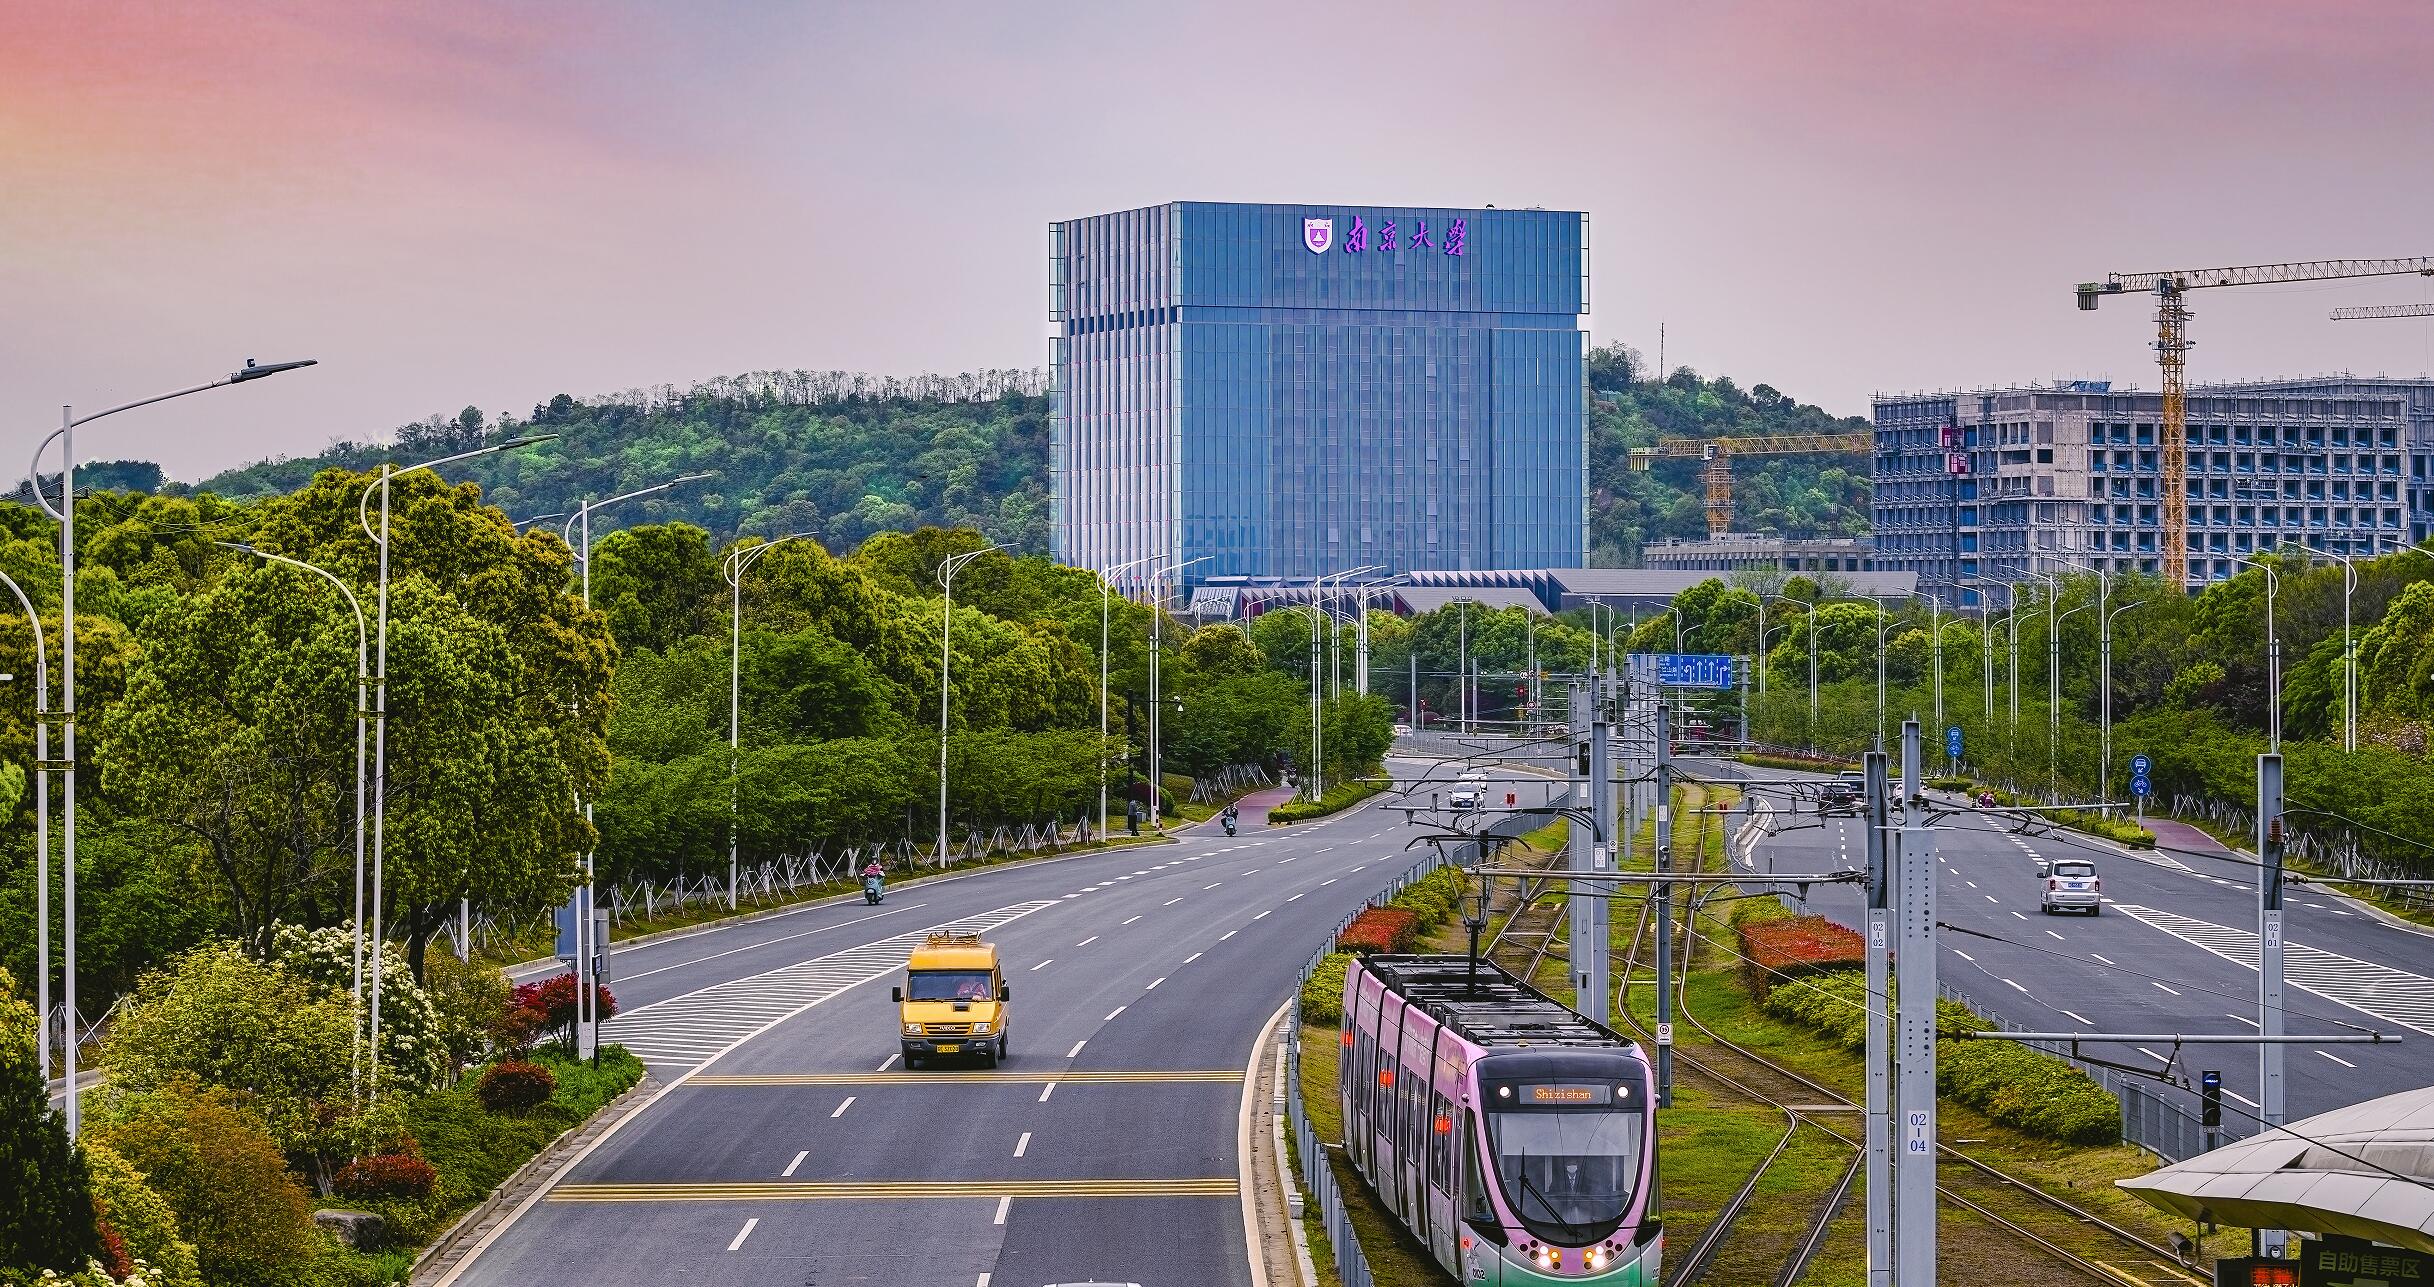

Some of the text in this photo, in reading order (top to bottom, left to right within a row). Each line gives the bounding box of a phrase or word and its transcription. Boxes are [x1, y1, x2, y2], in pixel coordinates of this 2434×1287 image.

[1873, 923, 1884, 931] 02
[2268, 923, 2279, 931] 02
[1873, 938, 1884, 947] 02
[2267, 939, 2277, 947] 01
[1535, 1088, 1592, 1099] Shizishan
[1910, 1113, 1927, 1126] 02
[1910, 1139, 1926, 1152] 04
[2319, 1249, 2421, 1279] 自助售票区
